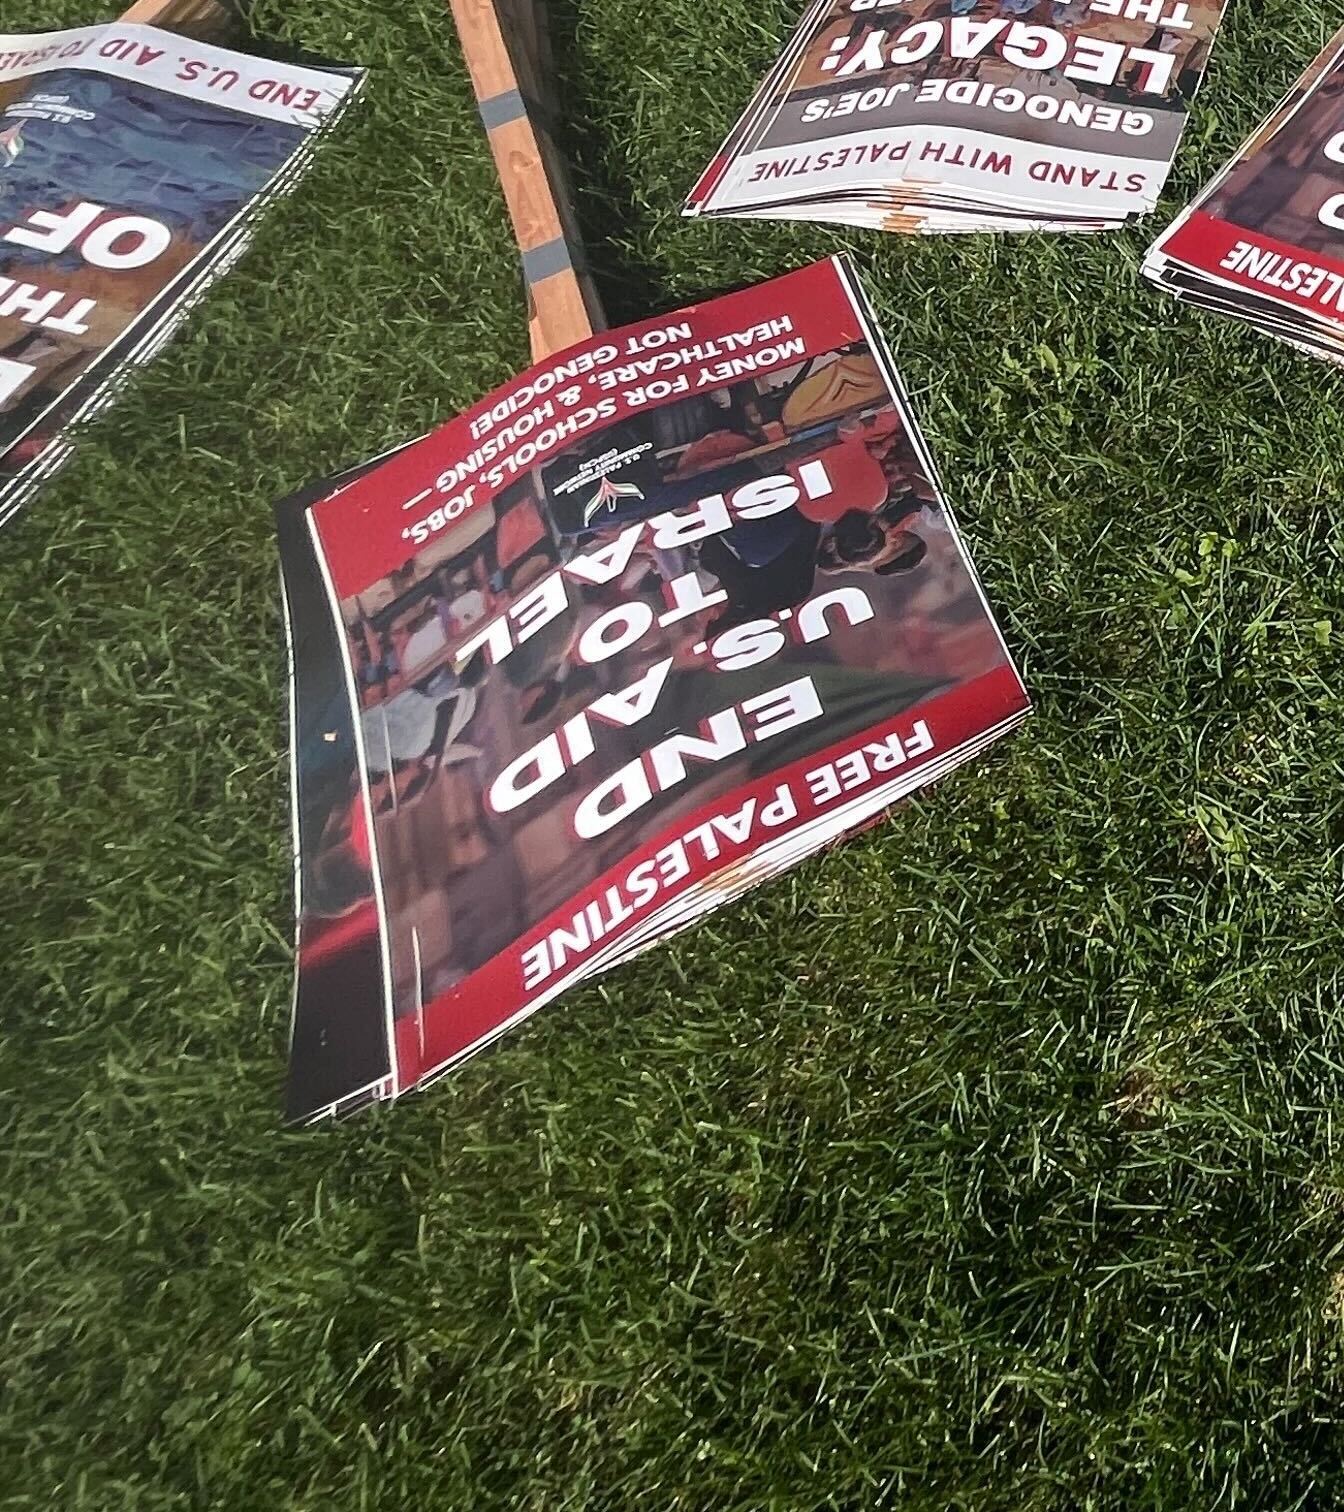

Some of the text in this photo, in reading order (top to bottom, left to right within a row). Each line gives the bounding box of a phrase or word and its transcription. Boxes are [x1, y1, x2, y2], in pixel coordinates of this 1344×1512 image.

[98, 37, 321, 111] END U.S. AID
[821, 16, 1176, 94] LEGACY:
[801, 76, 1155, 136] GENOCIDE JOE'S
[748, 140, 1147, 193] STAND WITH PALESTINE
[2, 200, 172, 270] OF
[455, 457, 834, 666] ISRAEL
[578, 571, 728, 664] TO
[488, 586, 878, 814] U.S. AID
[572, 675, 826, 840] END
[519, 718, 935, 992] FREE PALESTINE
